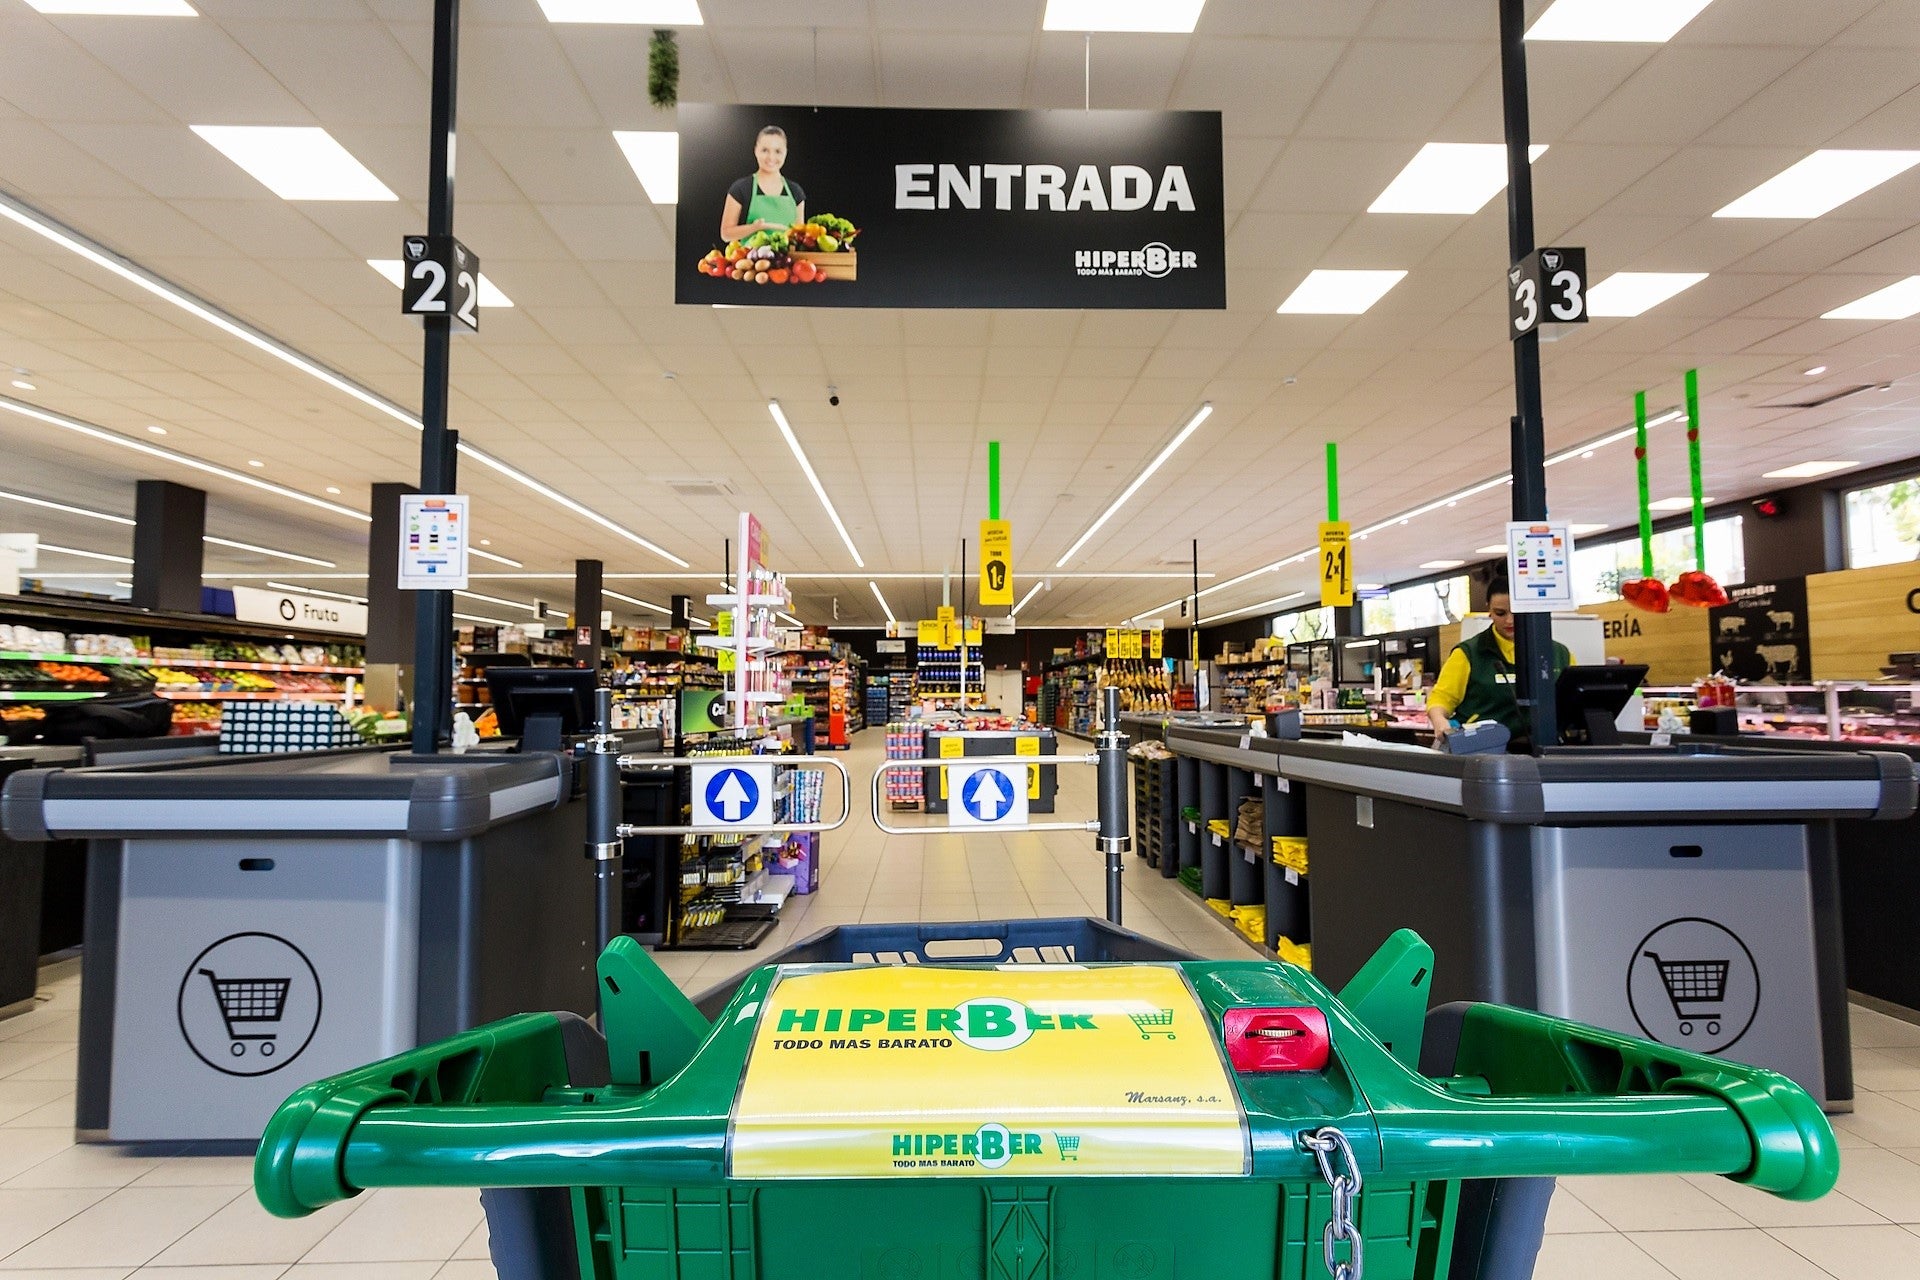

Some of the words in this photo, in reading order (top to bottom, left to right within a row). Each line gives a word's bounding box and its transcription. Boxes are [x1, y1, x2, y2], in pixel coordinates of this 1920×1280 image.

[895, 164, 1196, 212] ENTRADA
[1075, 247, 1197, 272] HIPERBER
[411, 260, 446, 312] 2
[457, 271, 477, 328] 2
[1514, 278, 1538, 331] 3
[1550, 270, 1583, 321] 3
[777, 1004, 1099, 1038] HIPERBER
[773, 1039, 823, 1050] TODO
[829, 1039, 871, 1049] MAS
[878, 1038, 953, 1049] BARATO
[892, 1130, 1043, 1160] HIPERBER
[893, 1160, 916, 1168] TODO
[918, 1160, 938, 1168] MAS
[940, 1159, 975, 1167] BARATO
